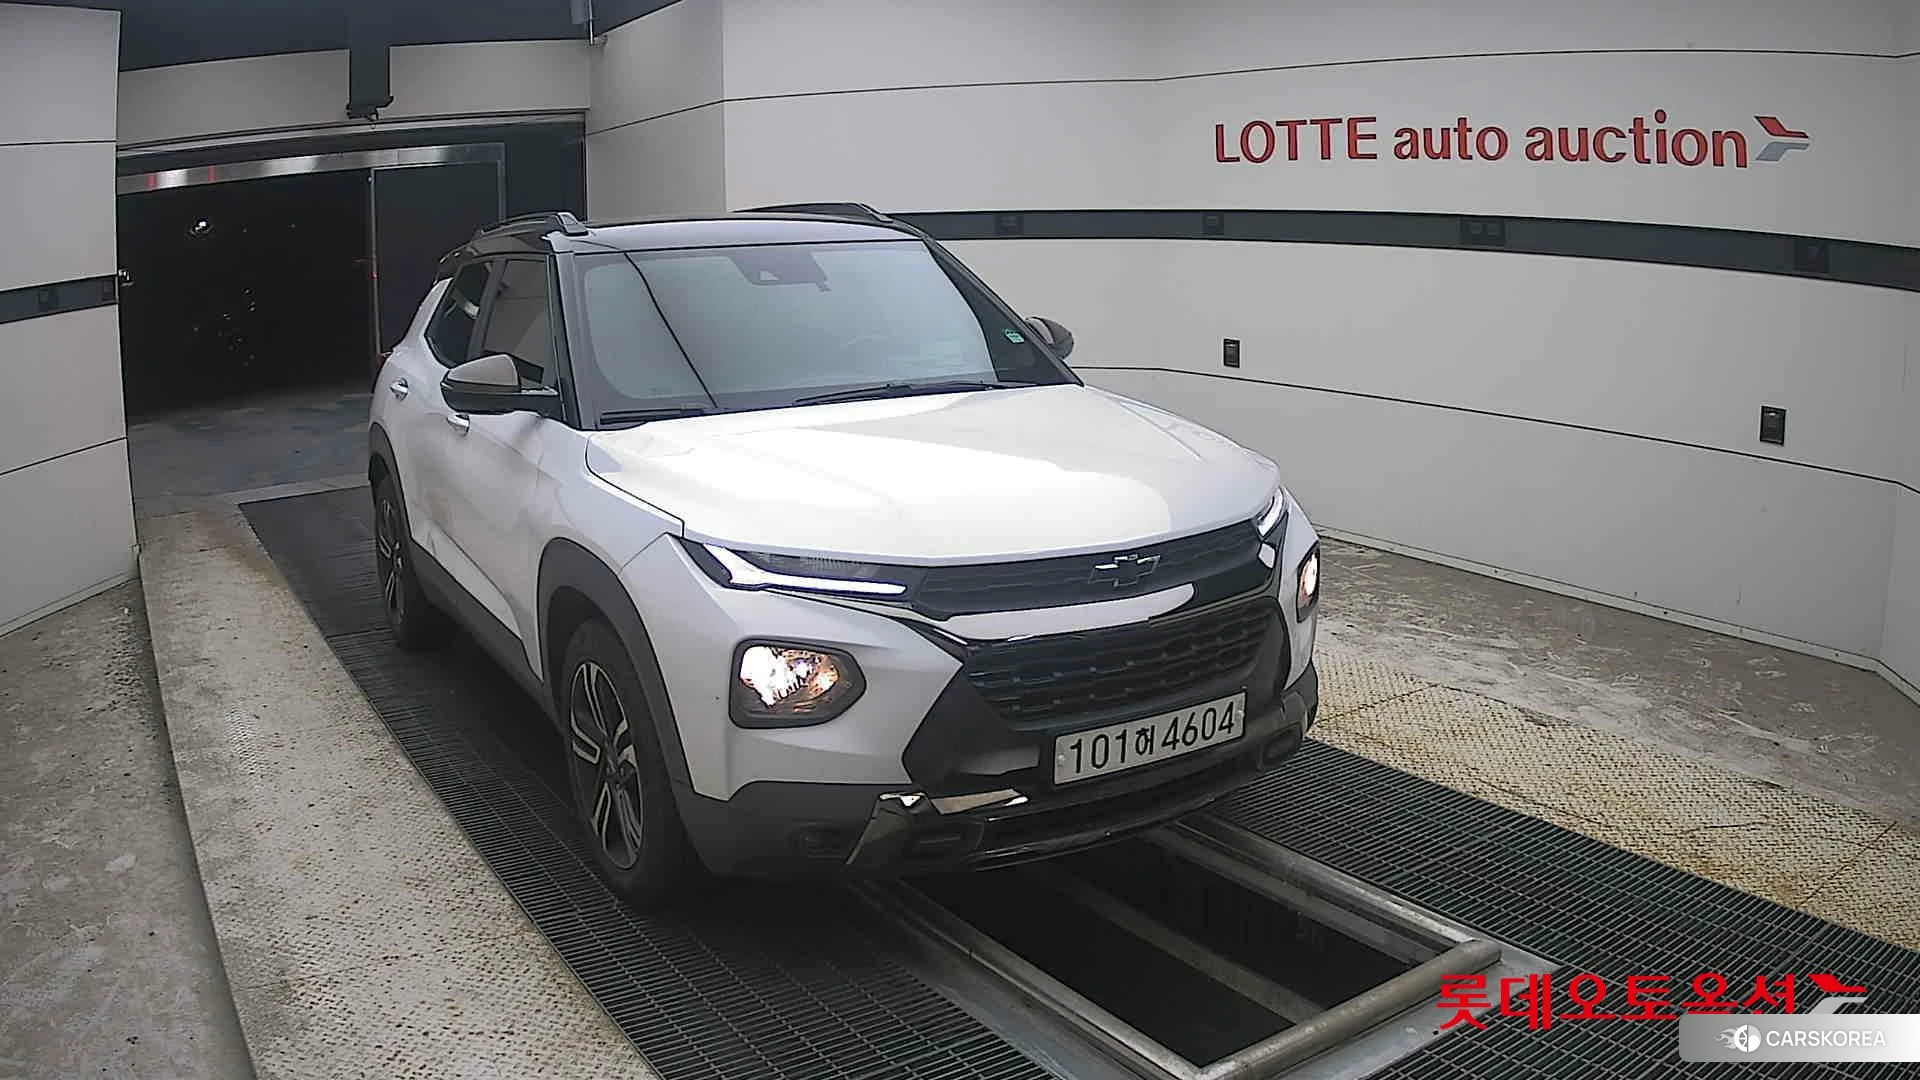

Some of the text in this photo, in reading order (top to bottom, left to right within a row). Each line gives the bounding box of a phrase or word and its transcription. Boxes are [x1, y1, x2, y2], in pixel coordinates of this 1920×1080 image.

[1215, 109, 1748, 168] LOTTE auto auction
